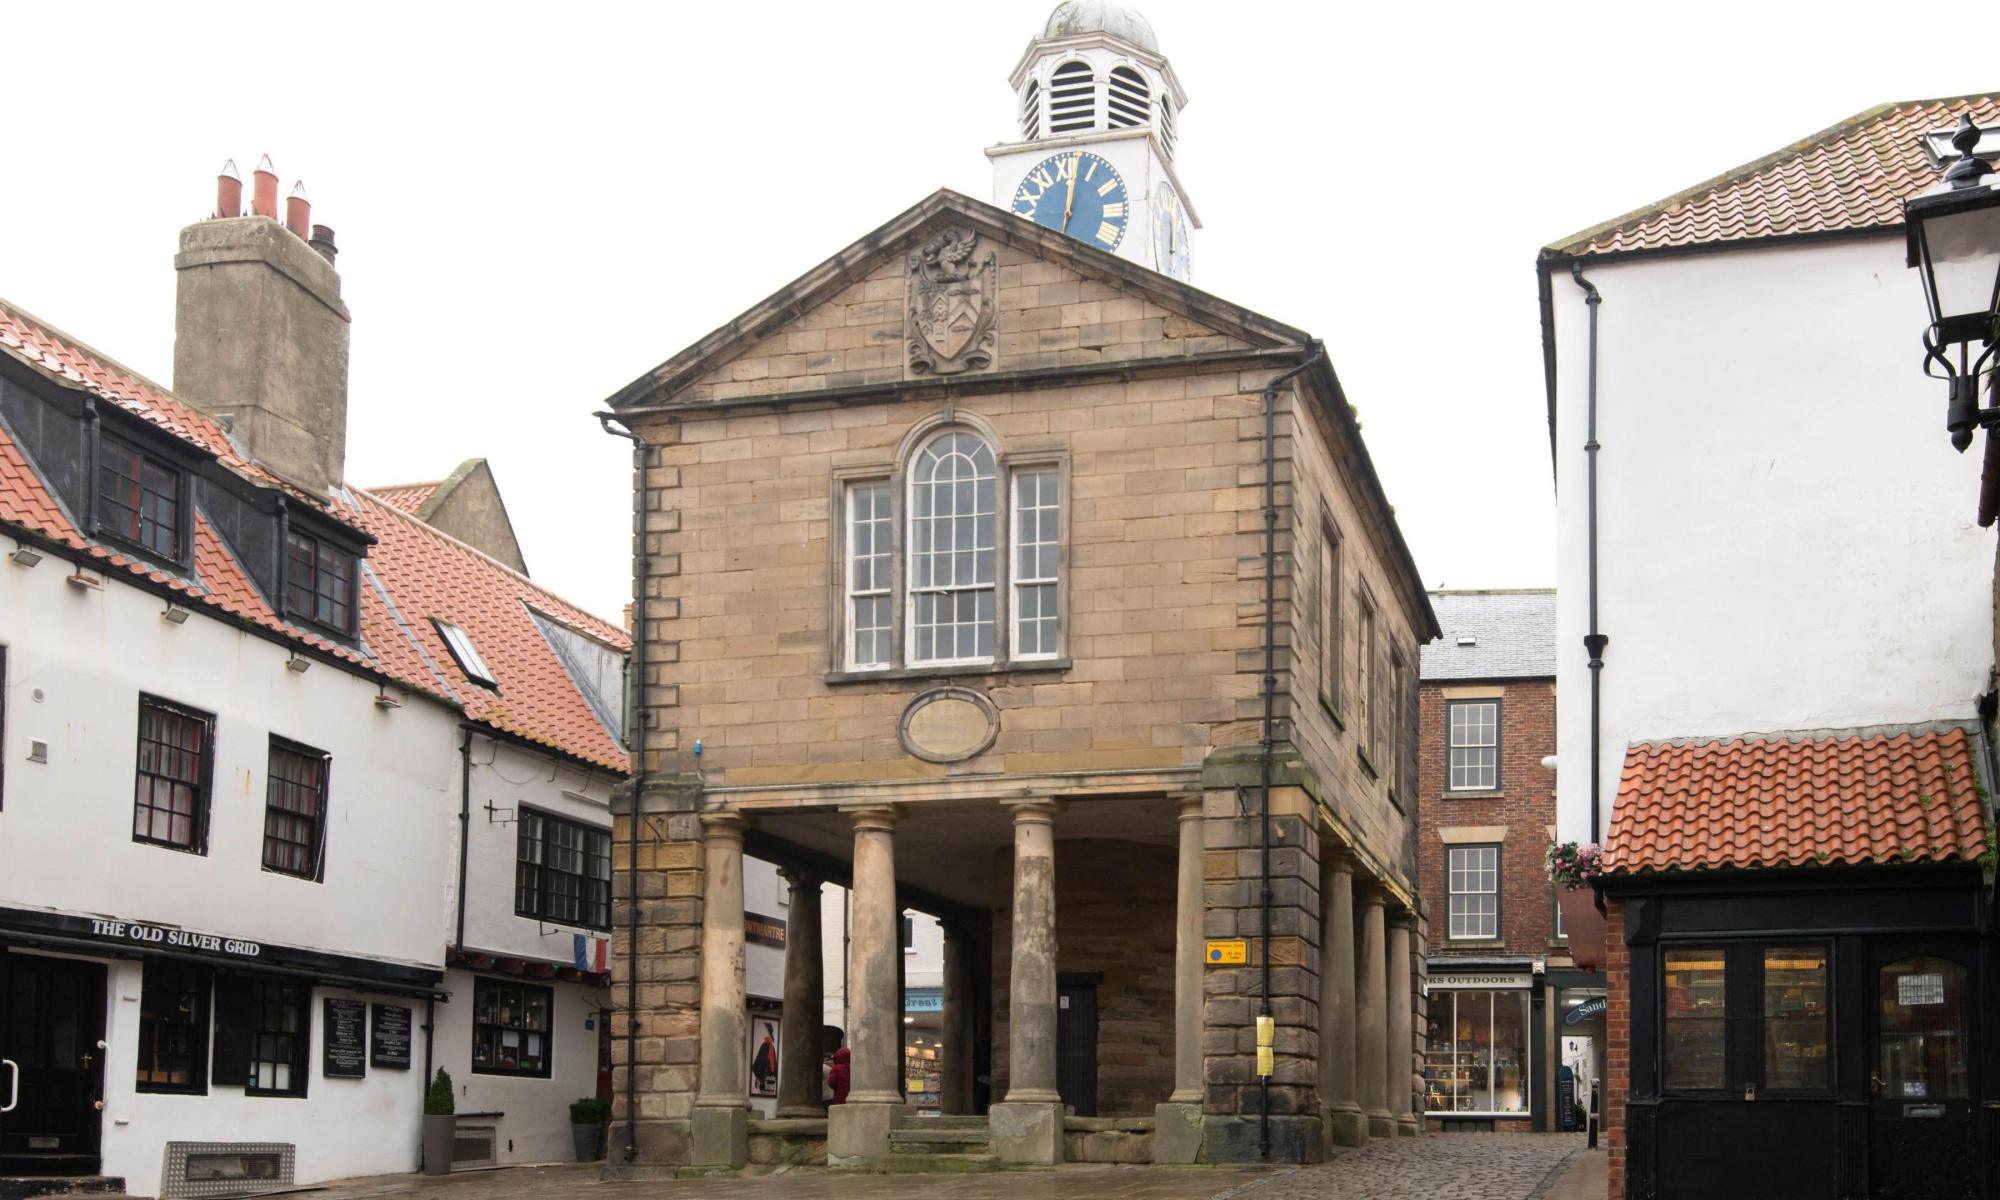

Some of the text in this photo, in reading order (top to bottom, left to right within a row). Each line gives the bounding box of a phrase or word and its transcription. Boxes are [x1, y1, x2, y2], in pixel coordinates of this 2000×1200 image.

[92, 919, 260, 956] THE OLD SILVER GRID
[1447, 976, 1515, 984] OUTDOORS
